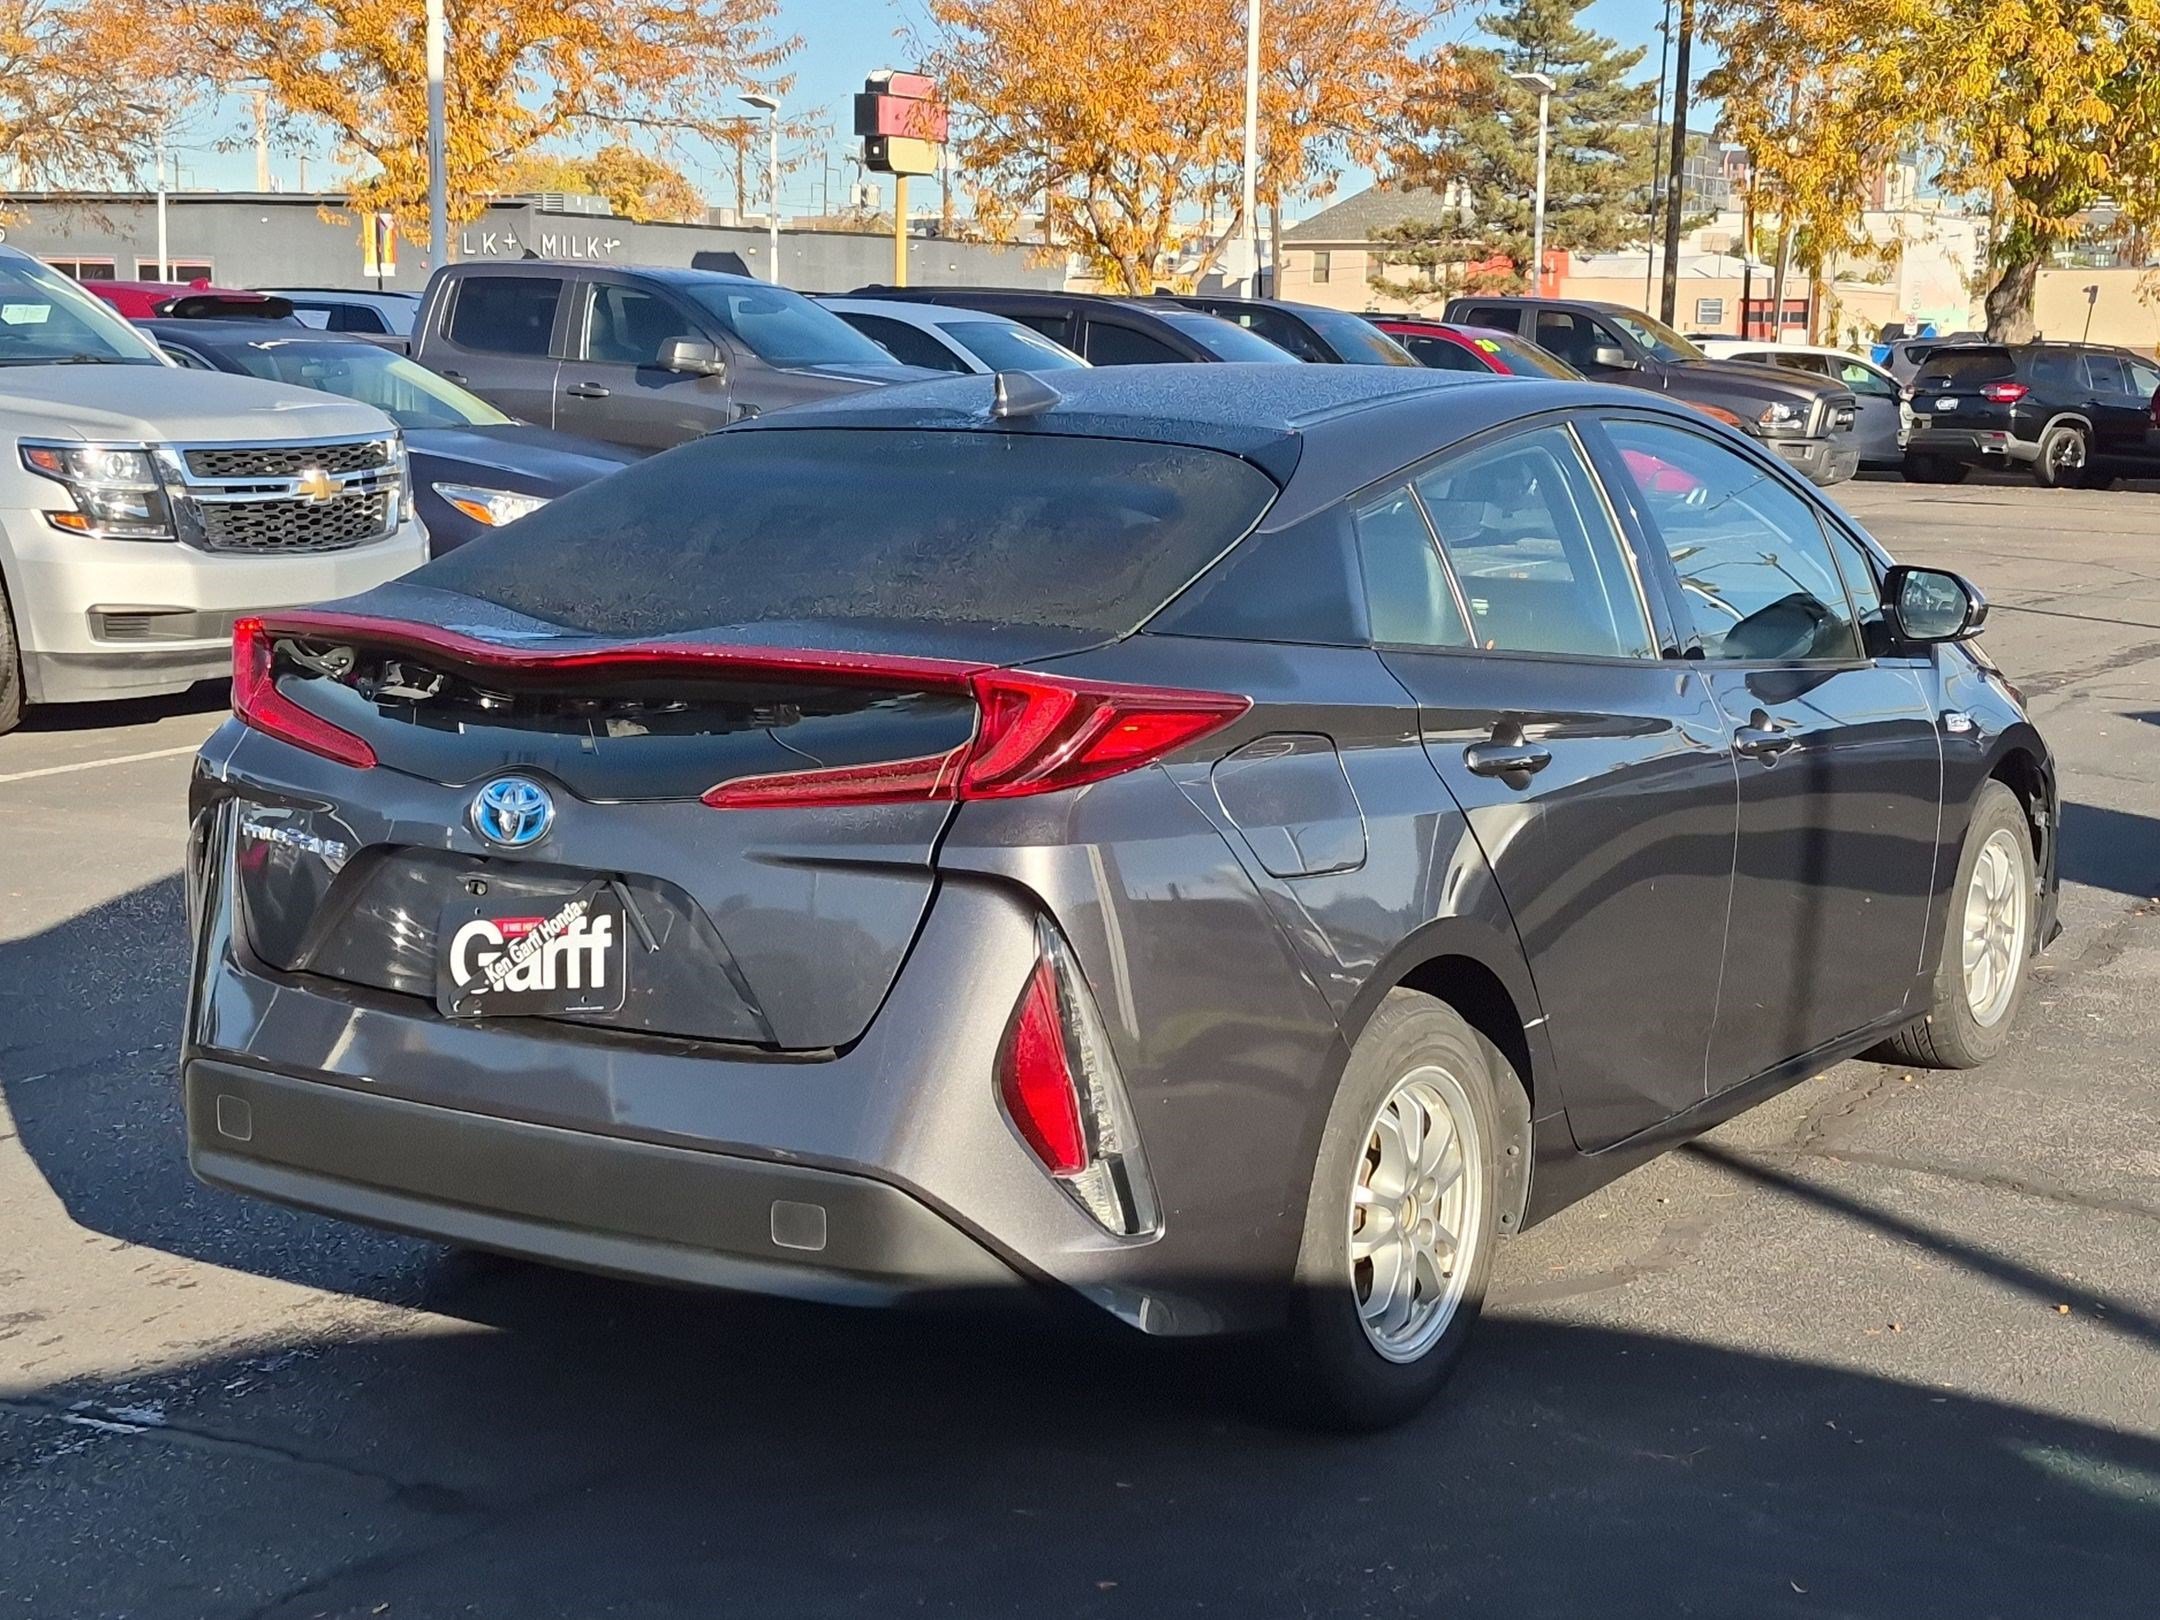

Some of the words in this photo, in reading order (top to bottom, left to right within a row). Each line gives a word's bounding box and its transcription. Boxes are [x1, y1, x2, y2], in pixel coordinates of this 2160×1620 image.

[483, 957, 514, 985] Ken
[508, 927, 545, 965] Garff
[543, 902, 584, 943] Honda
